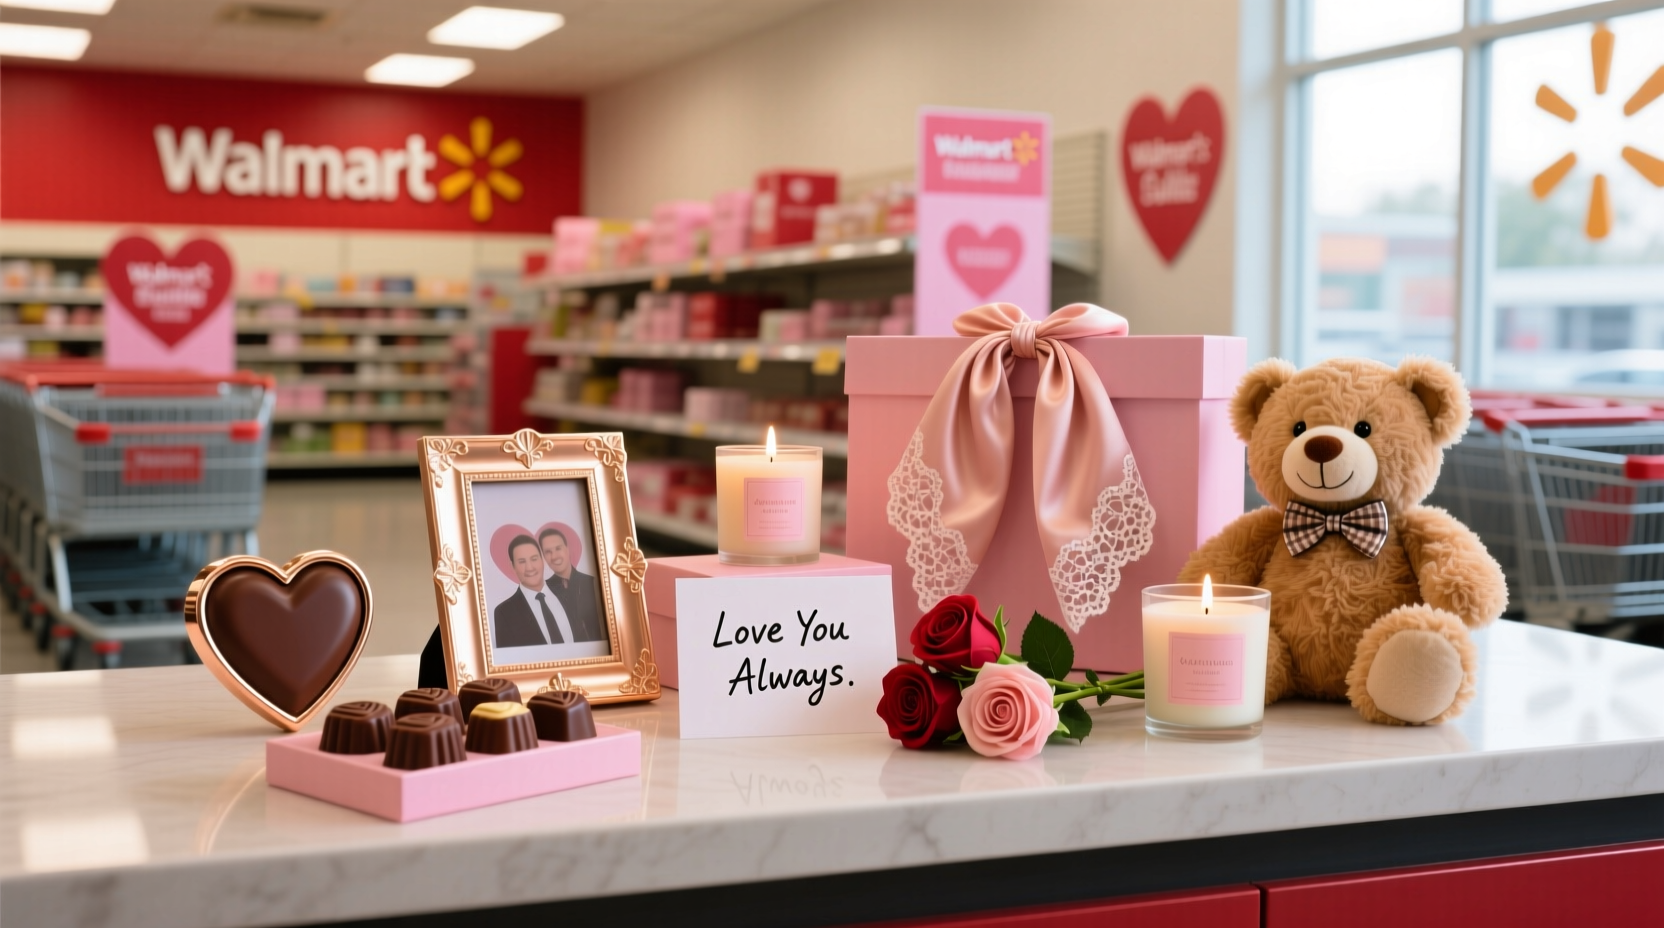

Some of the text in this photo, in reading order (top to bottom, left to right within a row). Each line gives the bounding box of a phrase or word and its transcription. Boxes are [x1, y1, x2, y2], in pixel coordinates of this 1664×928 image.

[155, 125, 437, 202] Walmart
[934, 133, 1013, 161] Walmart
[712, 609, 850, 648] Love You
[728, 657, 854, 707] Always.
